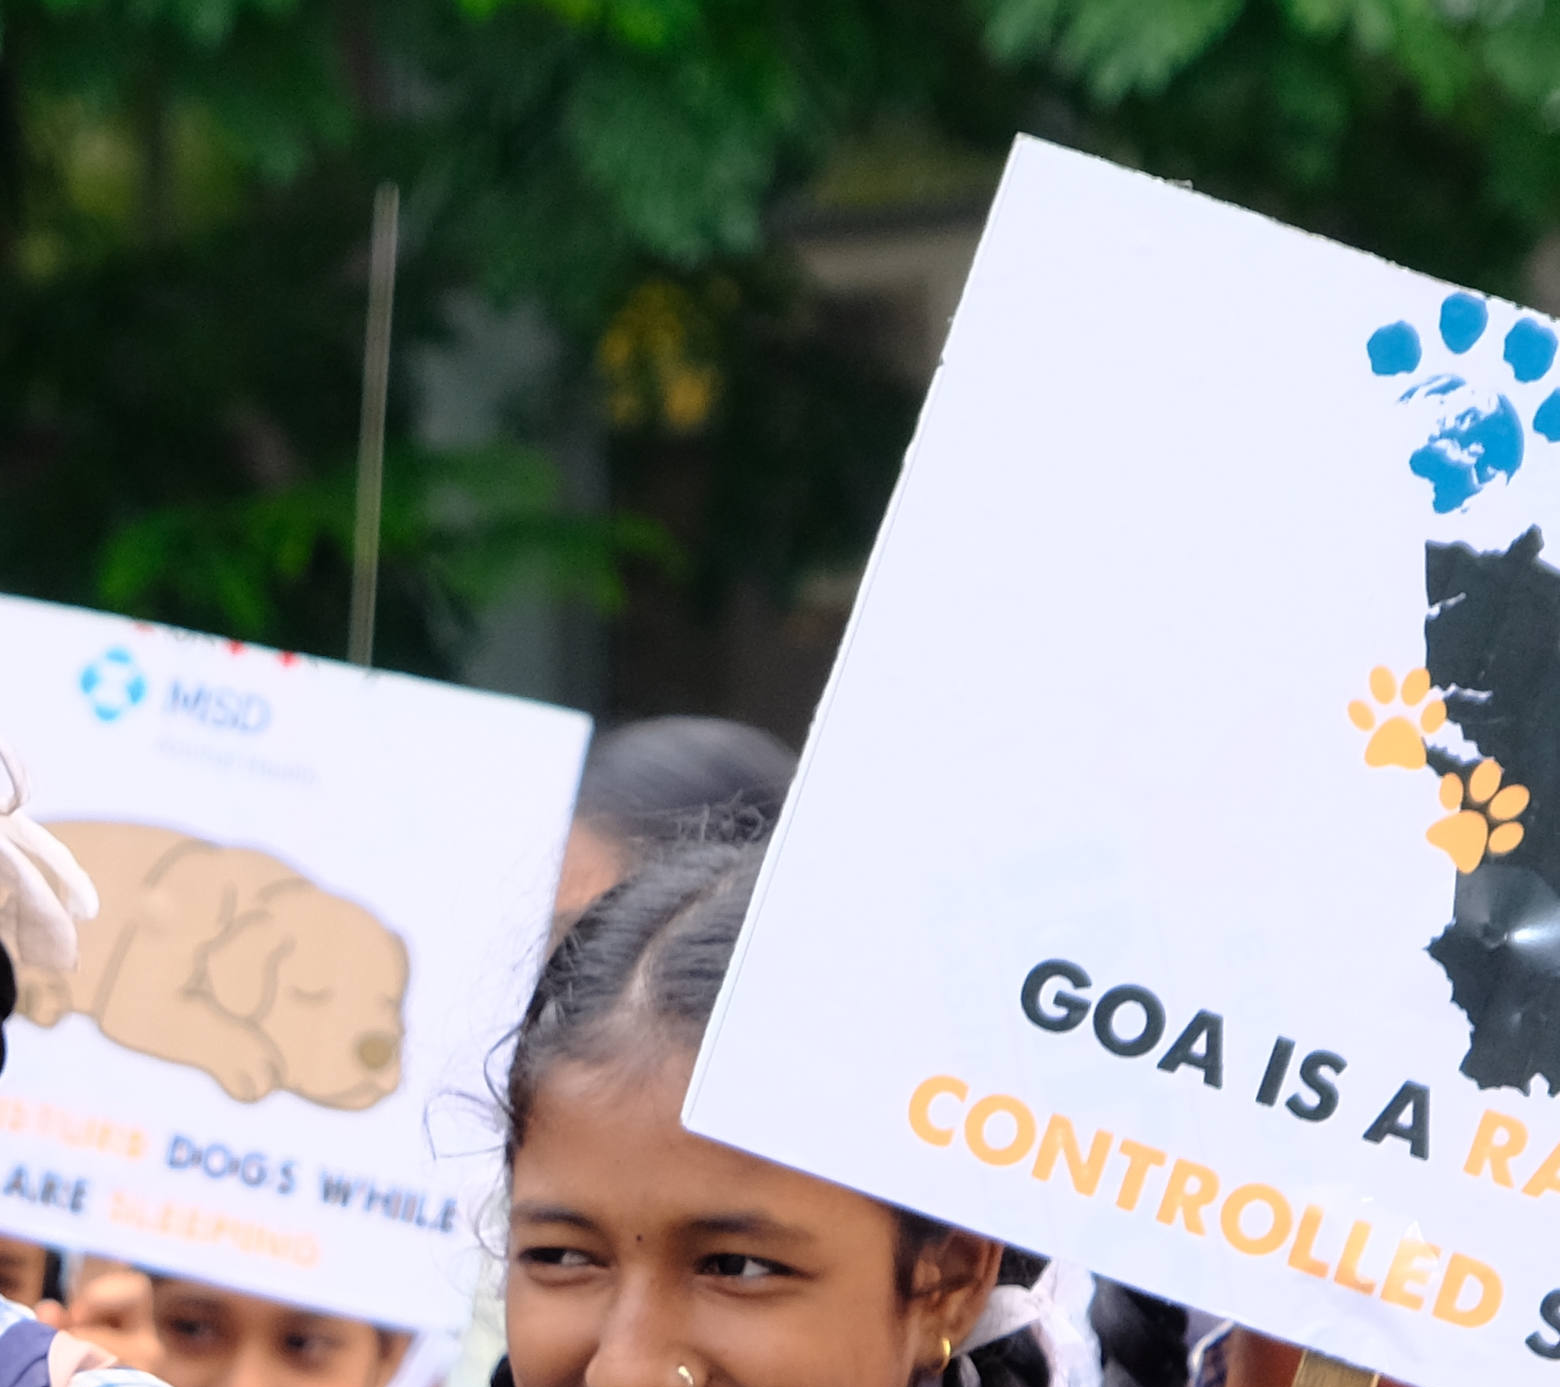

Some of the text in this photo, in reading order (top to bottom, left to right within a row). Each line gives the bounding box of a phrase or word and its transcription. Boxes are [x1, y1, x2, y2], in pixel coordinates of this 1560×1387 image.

[163, 679, 272, 734] MSD
[1021, 958, 1224, 1090] GOA
[1255, 1034, 1348, 1123] IS
[1362, 1079, 1431, 1162] A
[2, 1163, 92, 1215] ARE
[165, 1133, 298, 1197] DOGS
[317, 1167, 459, 1235] WHILE
[907, 1073, 1505, 1329] CONTROLLED
